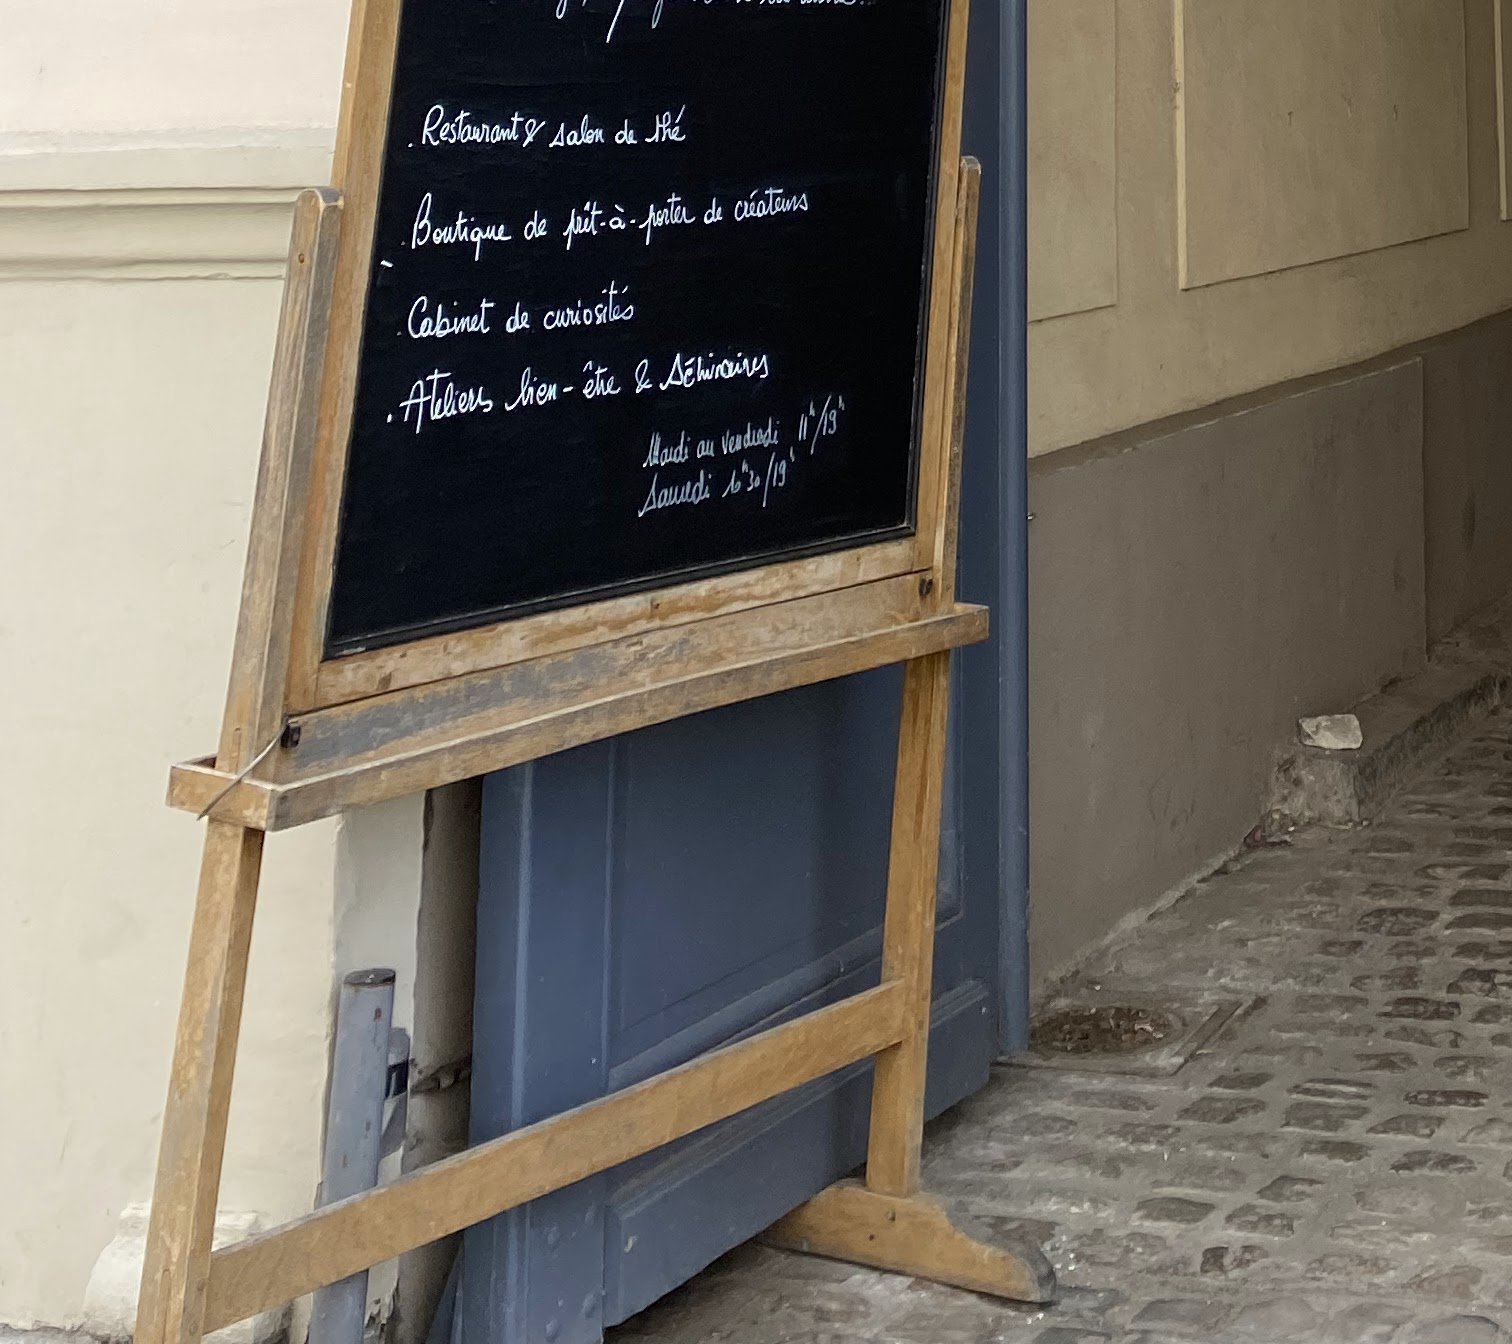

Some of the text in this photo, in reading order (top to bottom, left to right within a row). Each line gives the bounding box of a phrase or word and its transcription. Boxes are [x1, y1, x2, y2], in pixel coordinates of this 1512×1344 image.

[421, 104, 521, 146] Restaurant
[549, 114, 604, 148] salon
[614, 119, 638, 146] de
[645, 104, 687, 143] thé
[411, 192, 512, 261] Boutique
[524, 210, 548, 241] de
[703, 200, 723, 225] de
[734, 187, 809, 221] créateurs
[407, 280, 634, 339] Cabinet de curiosités
[399, 368, 495, 434] Ateliers
[634, 358, 653, 395] &
[642, 429, 692, 468] Mardi
[696, 439, 715, 459] au
[637, 469, 711, 518] Samedi
